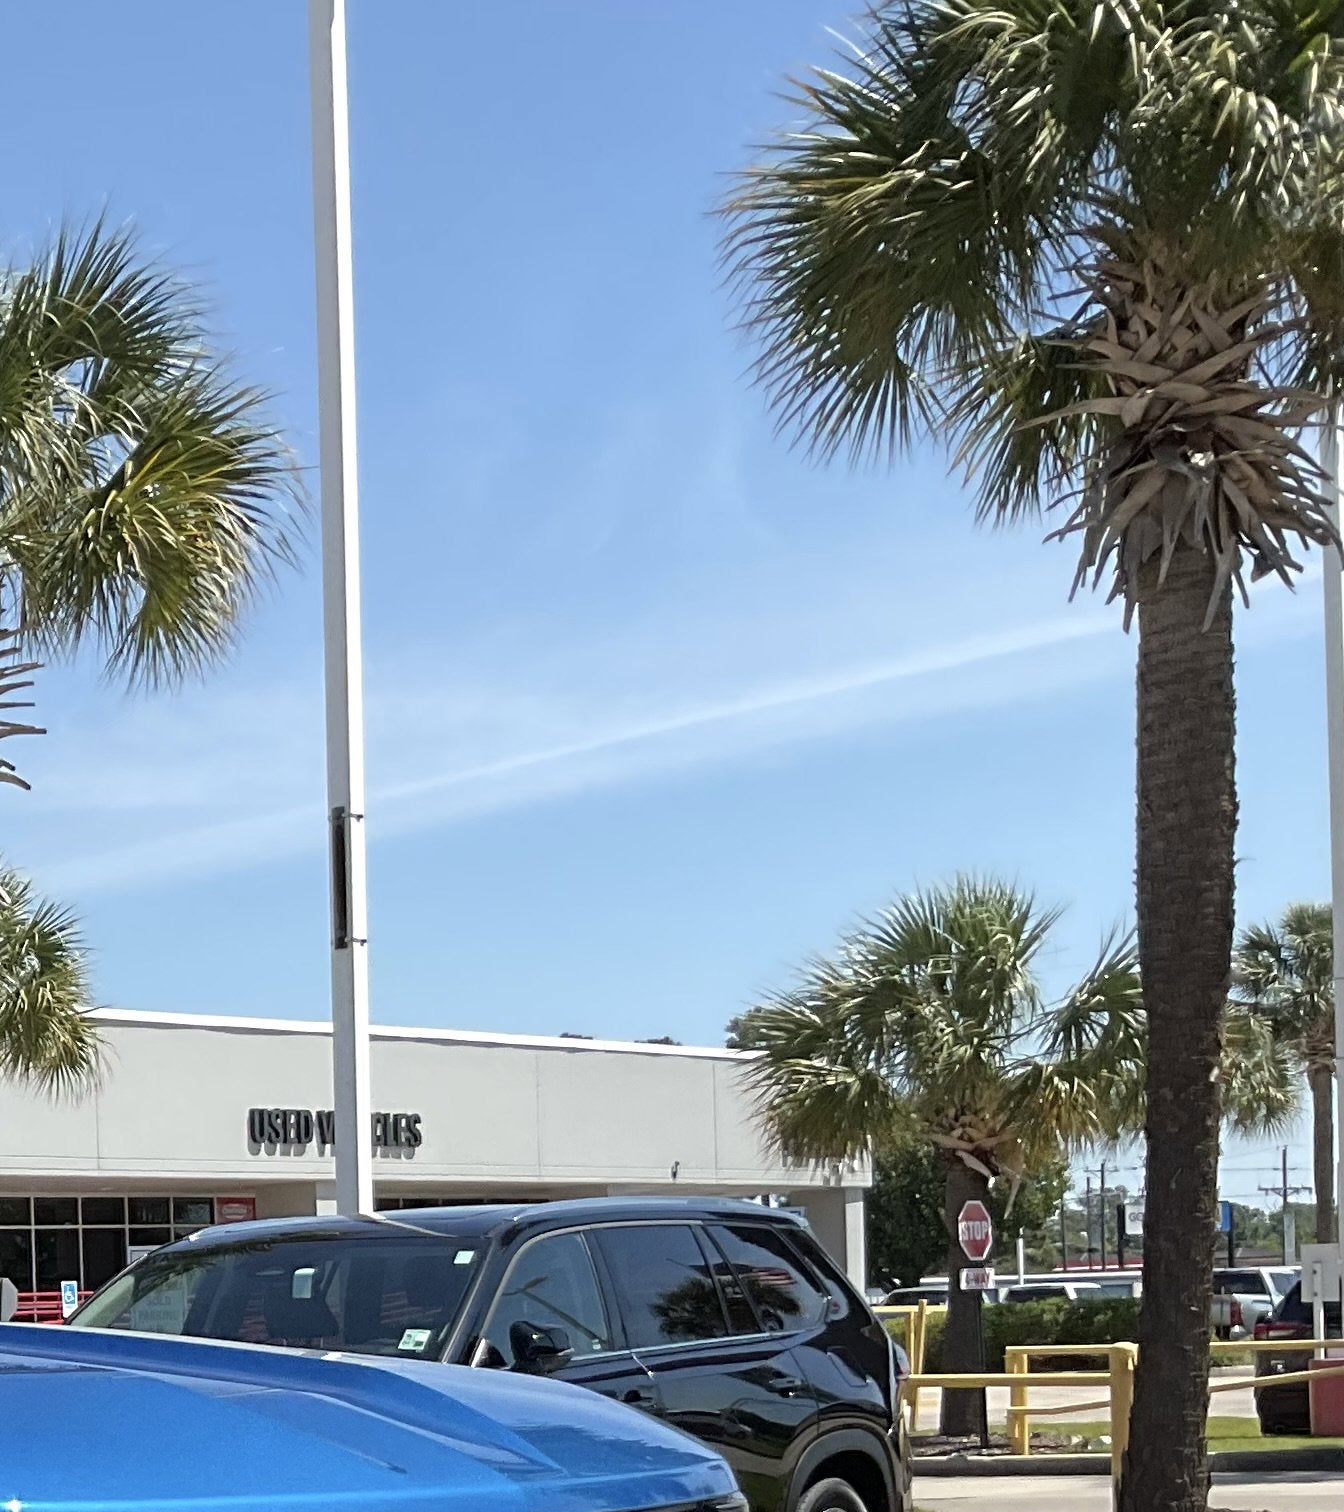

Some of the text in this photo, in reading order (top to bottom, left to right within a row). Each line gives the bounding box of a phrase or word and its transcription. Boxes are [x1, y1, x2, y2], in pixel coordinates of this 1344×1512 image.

[249, 1108, 421, 1148] USED VCLES
[961, 1220, 988, 1241] STOP
